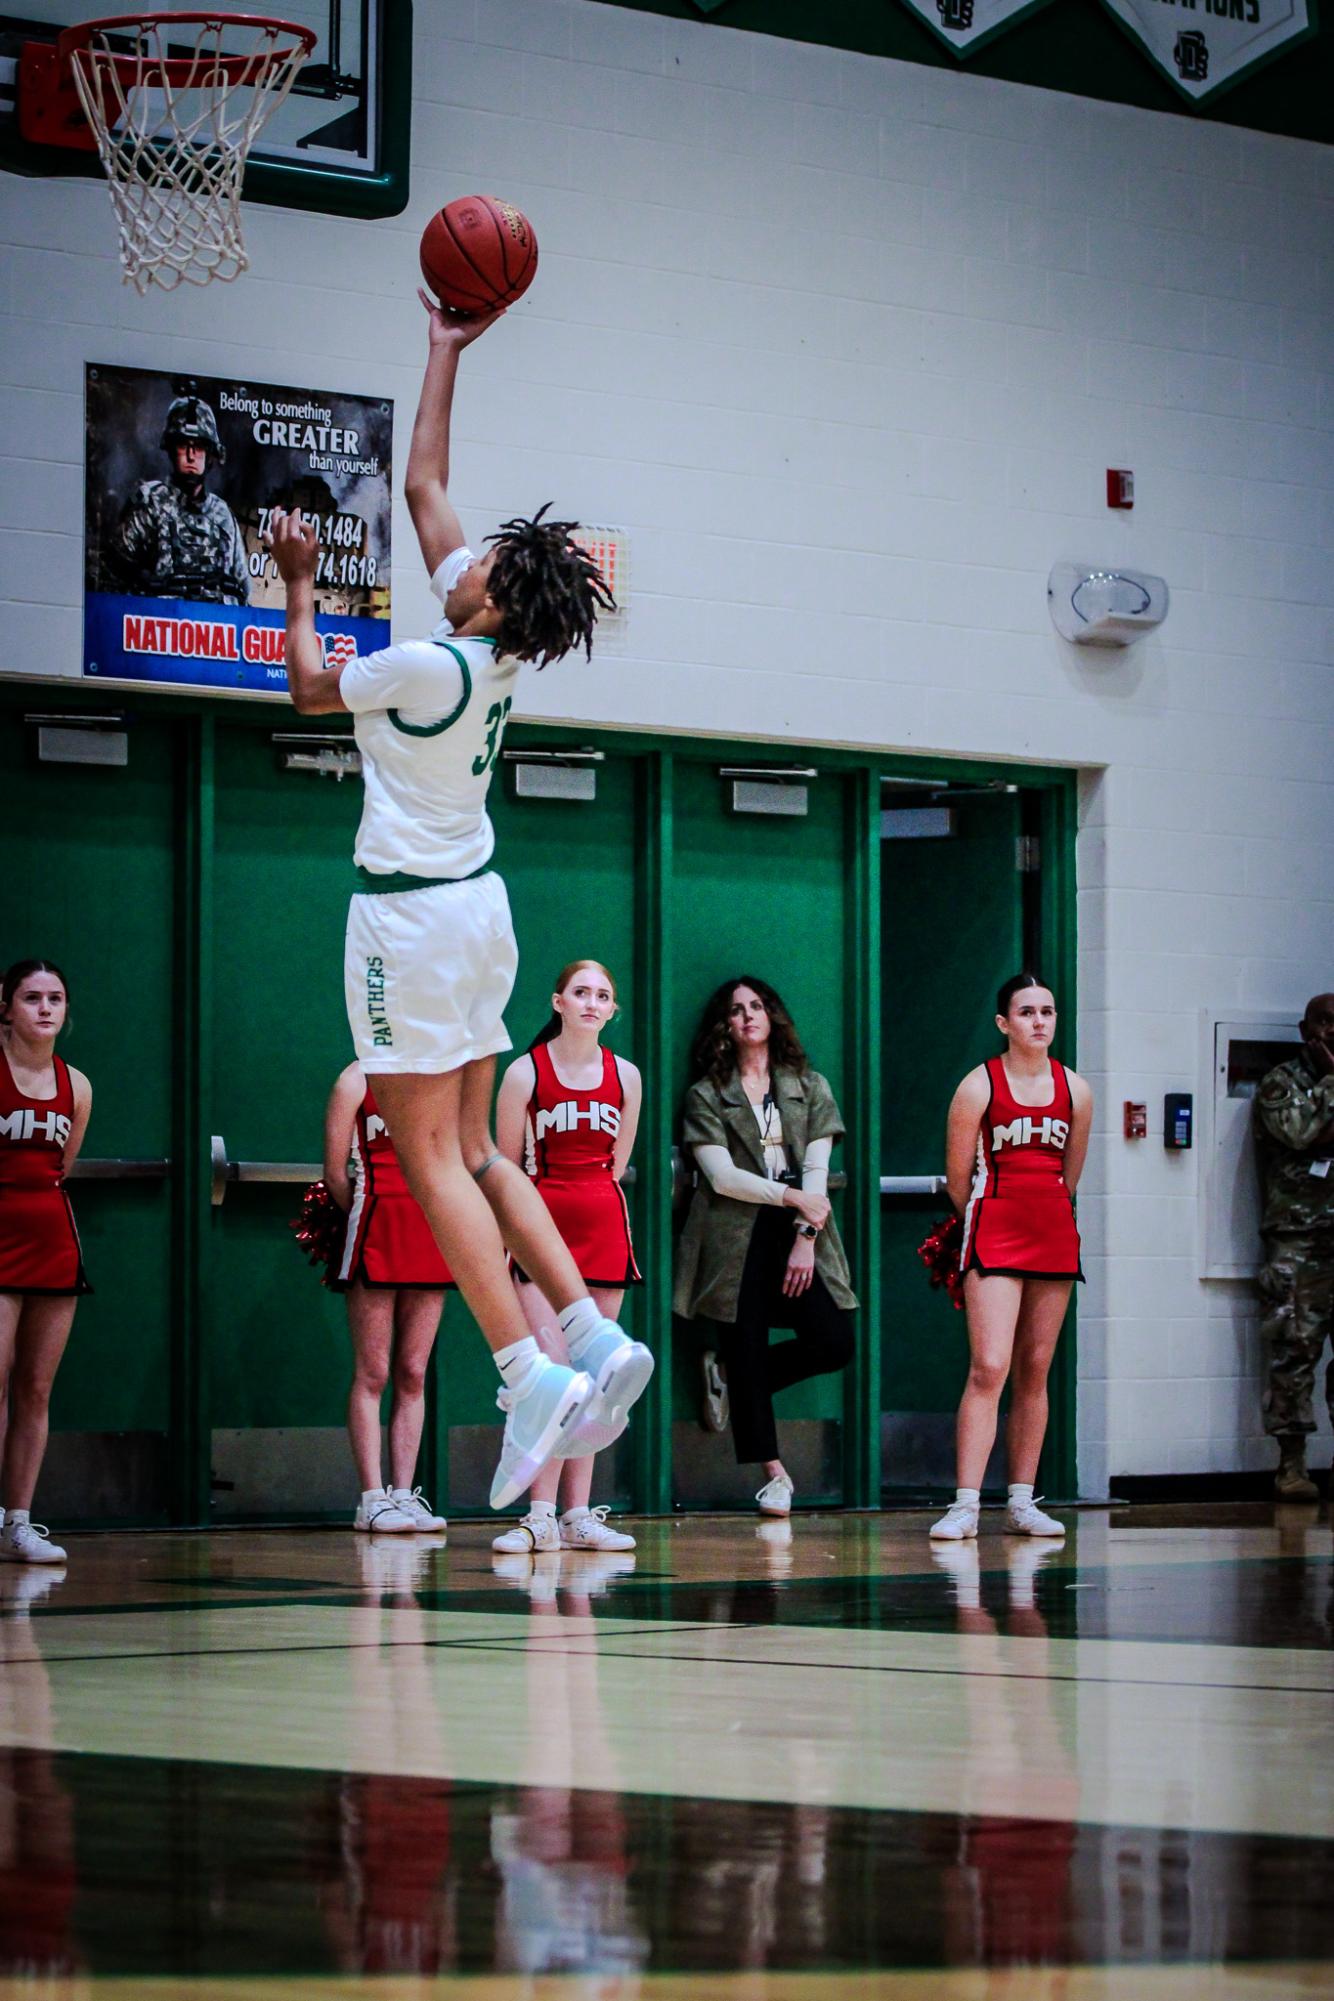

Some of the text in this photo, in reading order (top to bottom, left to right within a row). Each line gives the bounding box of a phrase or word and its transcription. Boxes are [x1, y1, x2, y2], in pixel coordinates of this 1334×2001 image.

[220, 391, 331, 427] Belong to something
[252, 419, 359, 456] GREATER
[309, 451, 379, 478] than yourself
[249, 552, 268, 577] or
[123, 615, 323, 667] NATIONAL GUA
[366, 956, 393, 1047] PANTHERS
[536, 1100, 621, 1140] MHS
[992, 1116, 1069, 1152] MHS
